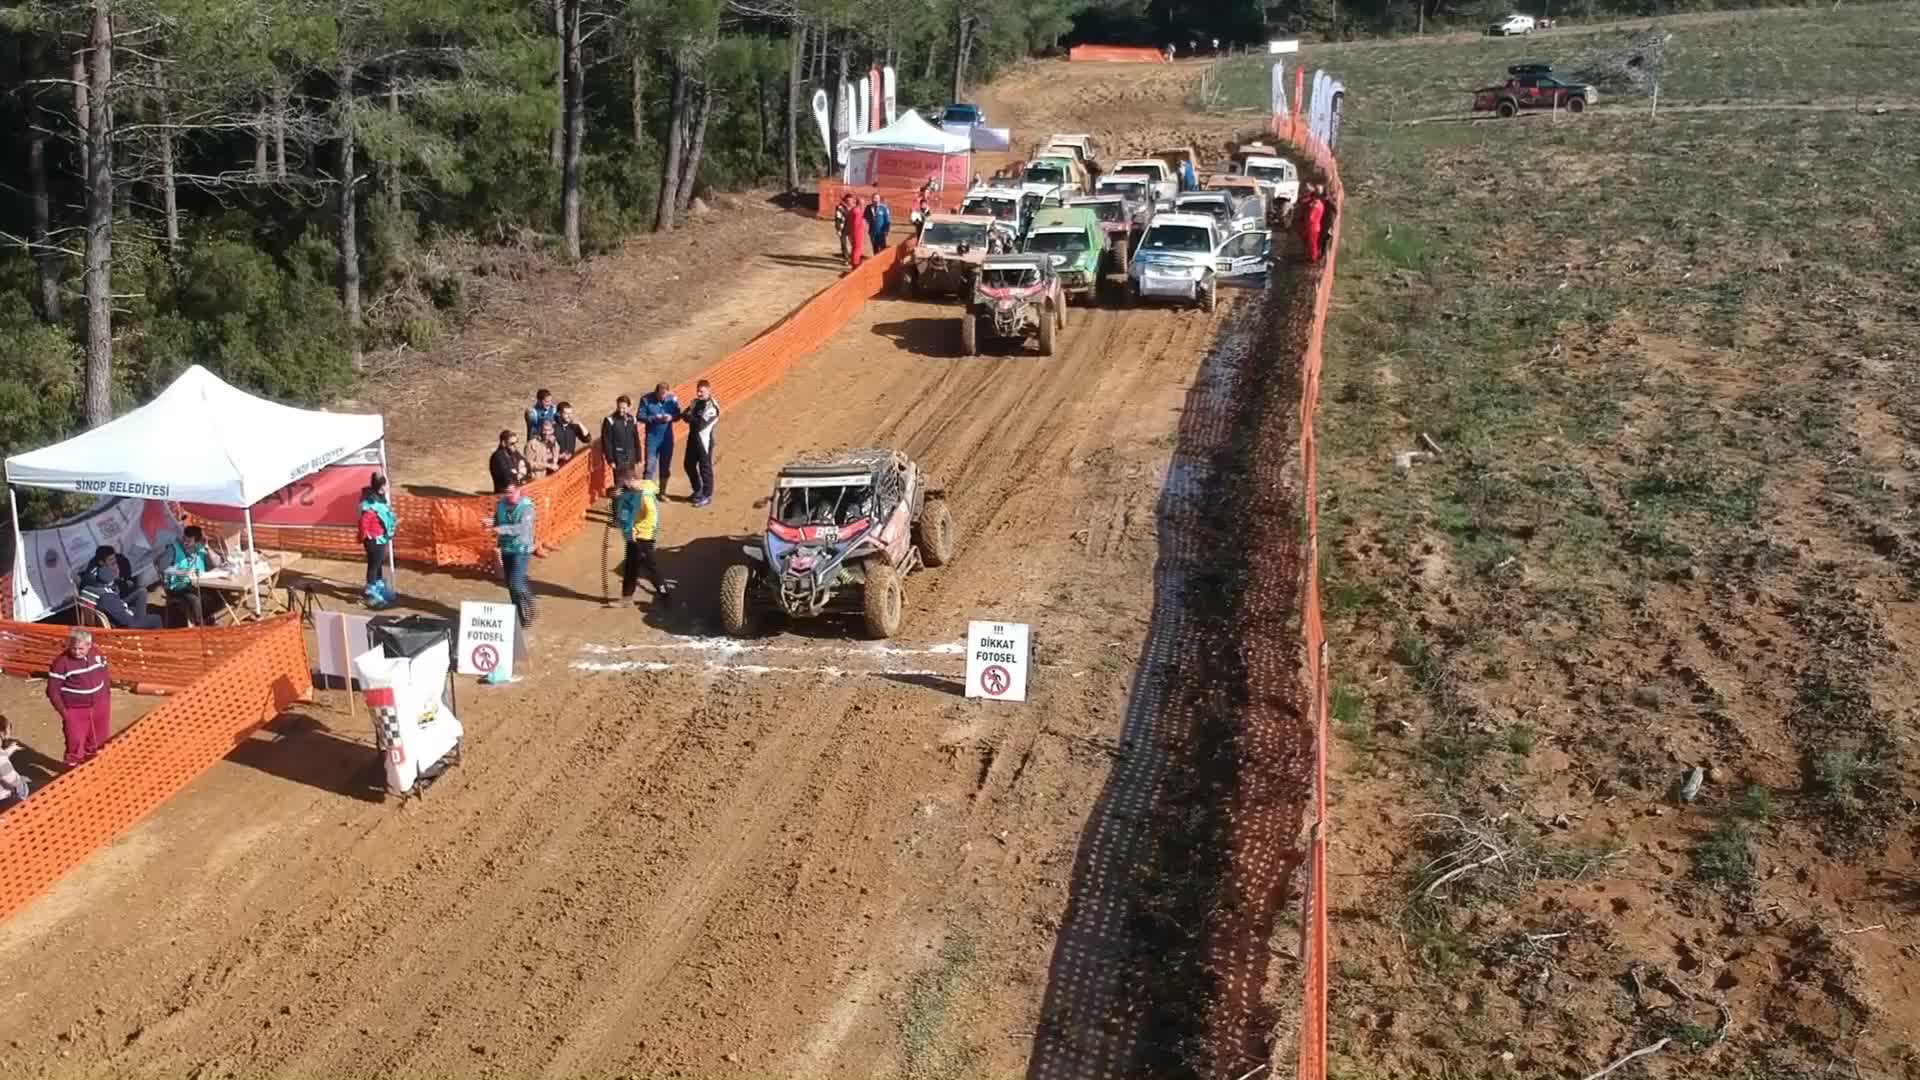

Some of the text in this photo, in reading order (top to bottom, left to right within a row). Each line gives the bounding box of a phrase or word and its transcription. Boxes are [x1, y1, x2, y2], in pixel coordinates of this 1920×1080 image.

[109, 481, 170, 497] BELEDİYESİ
[471, 616, 503, 629] DİKKAT
[467, 630, 505, 642] FOTOSEL
[980, 636, 1015, 649] DİKKAT
[976, 651, 1017, 664] FOTOSEL
